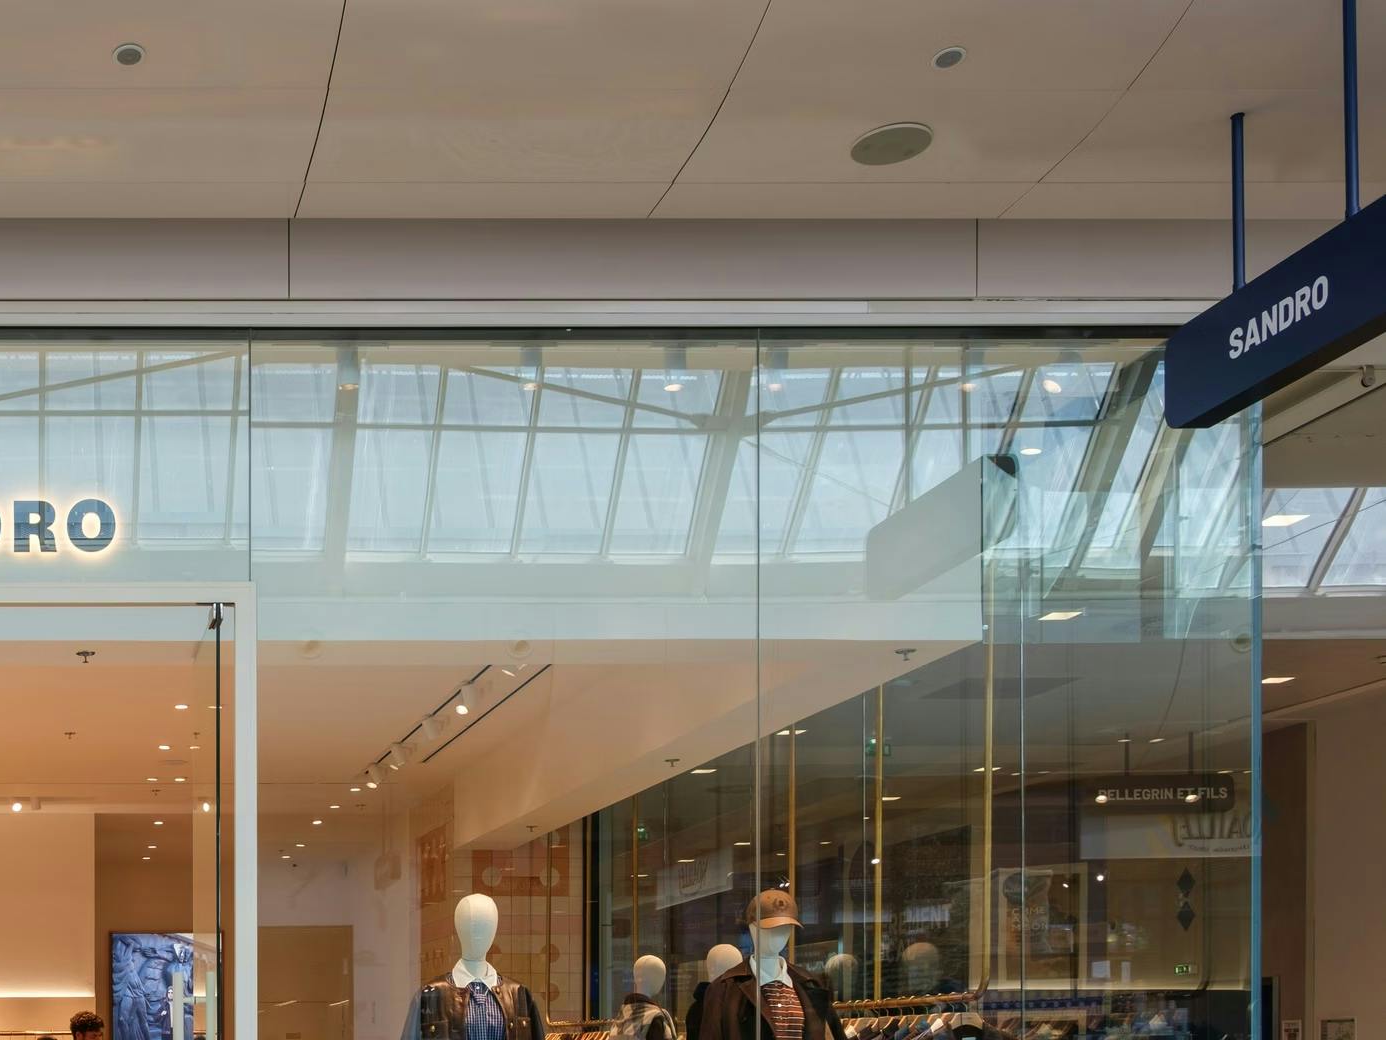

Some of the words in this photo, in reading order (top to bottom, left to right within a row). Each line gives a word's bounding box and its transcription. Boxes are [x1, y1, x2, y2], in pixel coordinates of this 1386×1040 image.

[1228, 275, 1329, 360] SANDRO
[1098, 787, 1174, 801] PELLEGRIN
[1197, 786, 1228, 800] FILS
